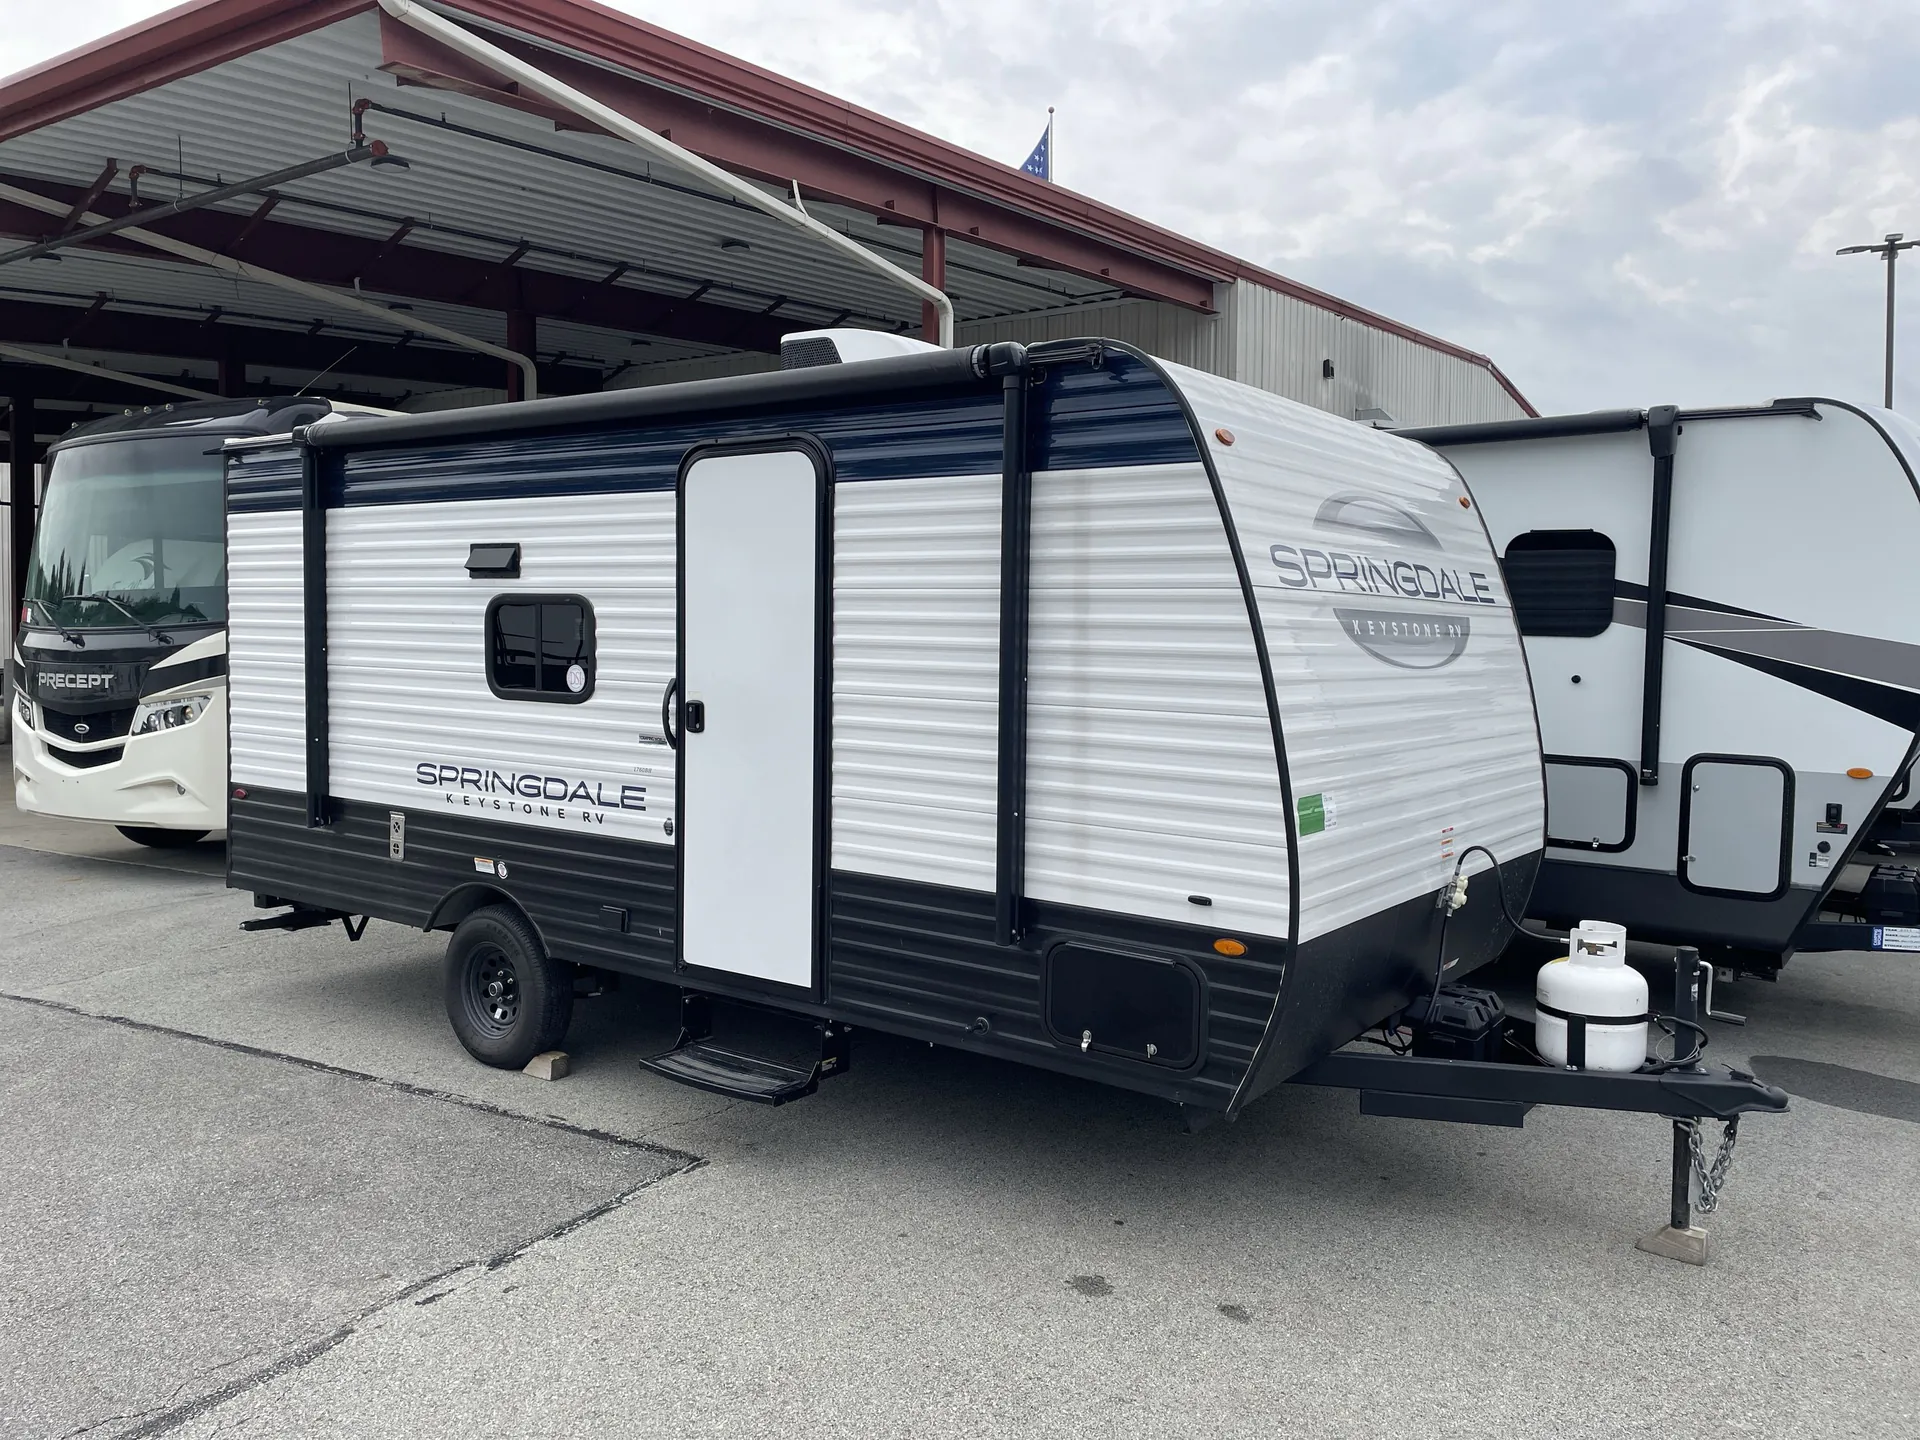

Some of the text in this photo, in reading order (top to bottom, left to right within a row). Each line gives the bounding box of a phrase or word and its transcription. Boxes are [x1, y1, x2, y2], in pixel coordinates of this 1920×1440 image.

[1269, 544, 1496, 604] SPRINGDALE
[1352, 619, 1462, 639] KEYSTONE RV
[38, 672, 115, 690] PRECEPT
[416, 762, 647, 812] SPRINGDALE
[446, 793, 605, 824] KEYSTONE RV
